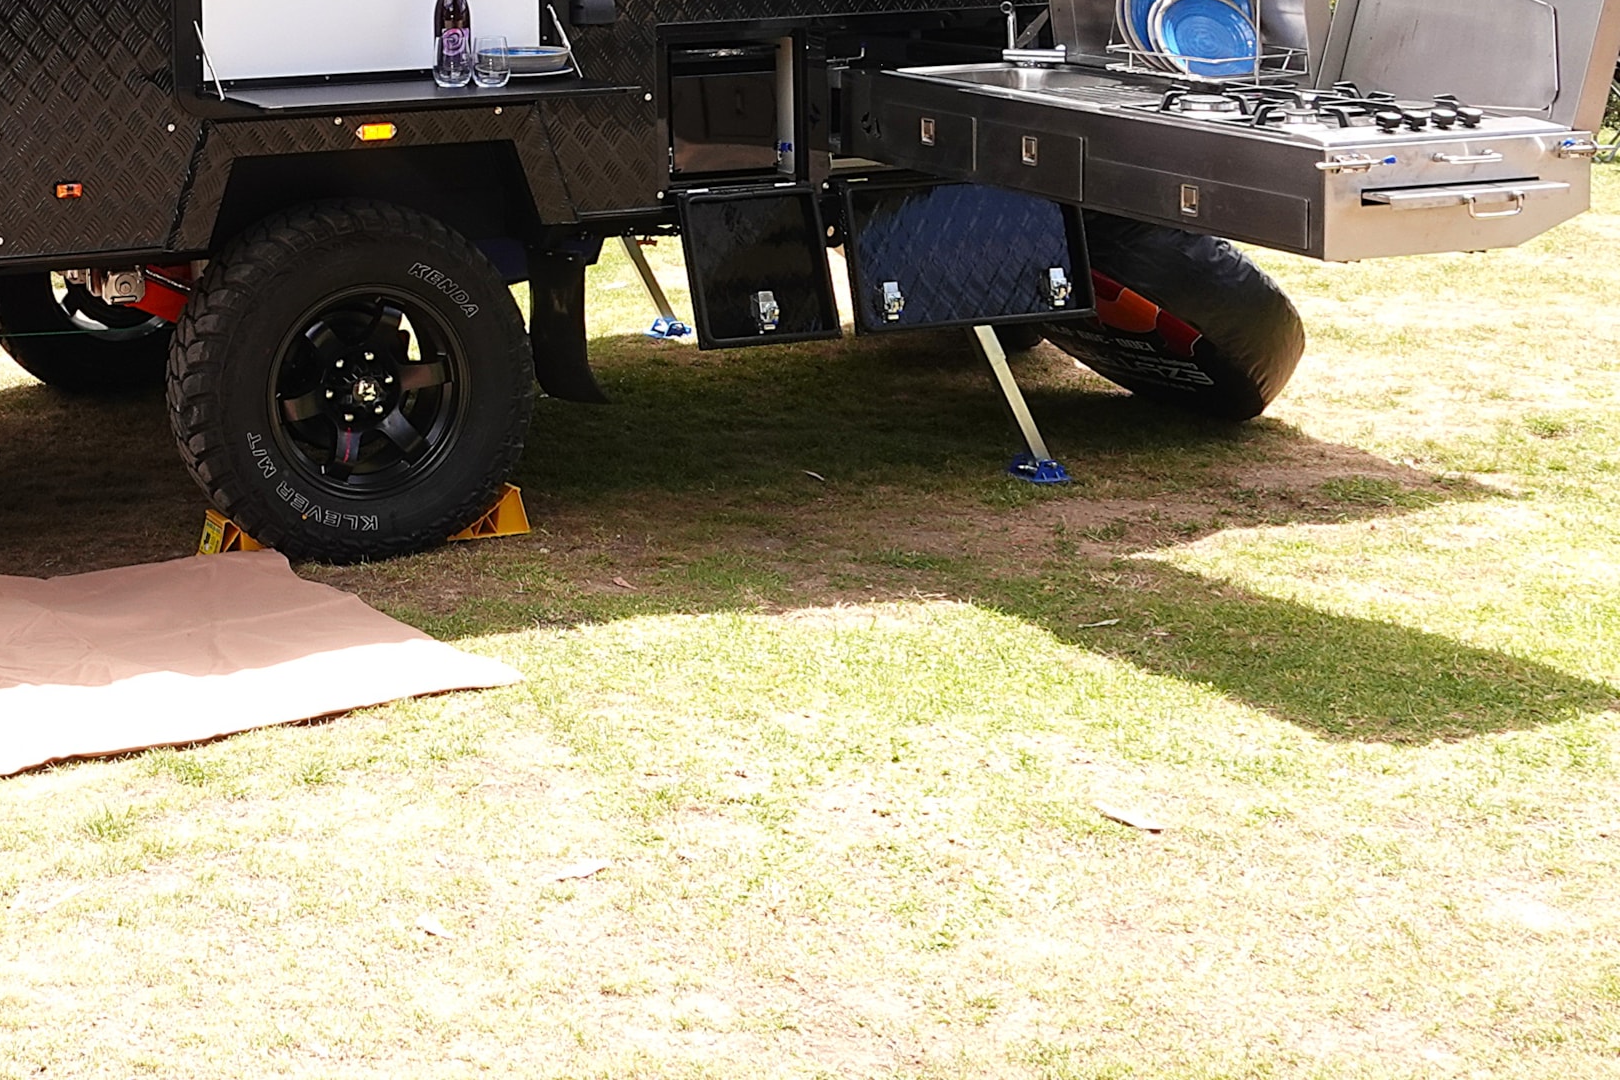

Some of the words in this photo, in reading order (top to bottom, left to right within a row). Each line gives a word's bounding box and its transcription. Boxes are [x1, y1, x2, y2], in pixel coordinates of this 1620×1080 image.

[407, 262, 480, 318] KENDA
[246, 431, 277, 479] M/T
[275, 480, 379, 531] KLEVER
